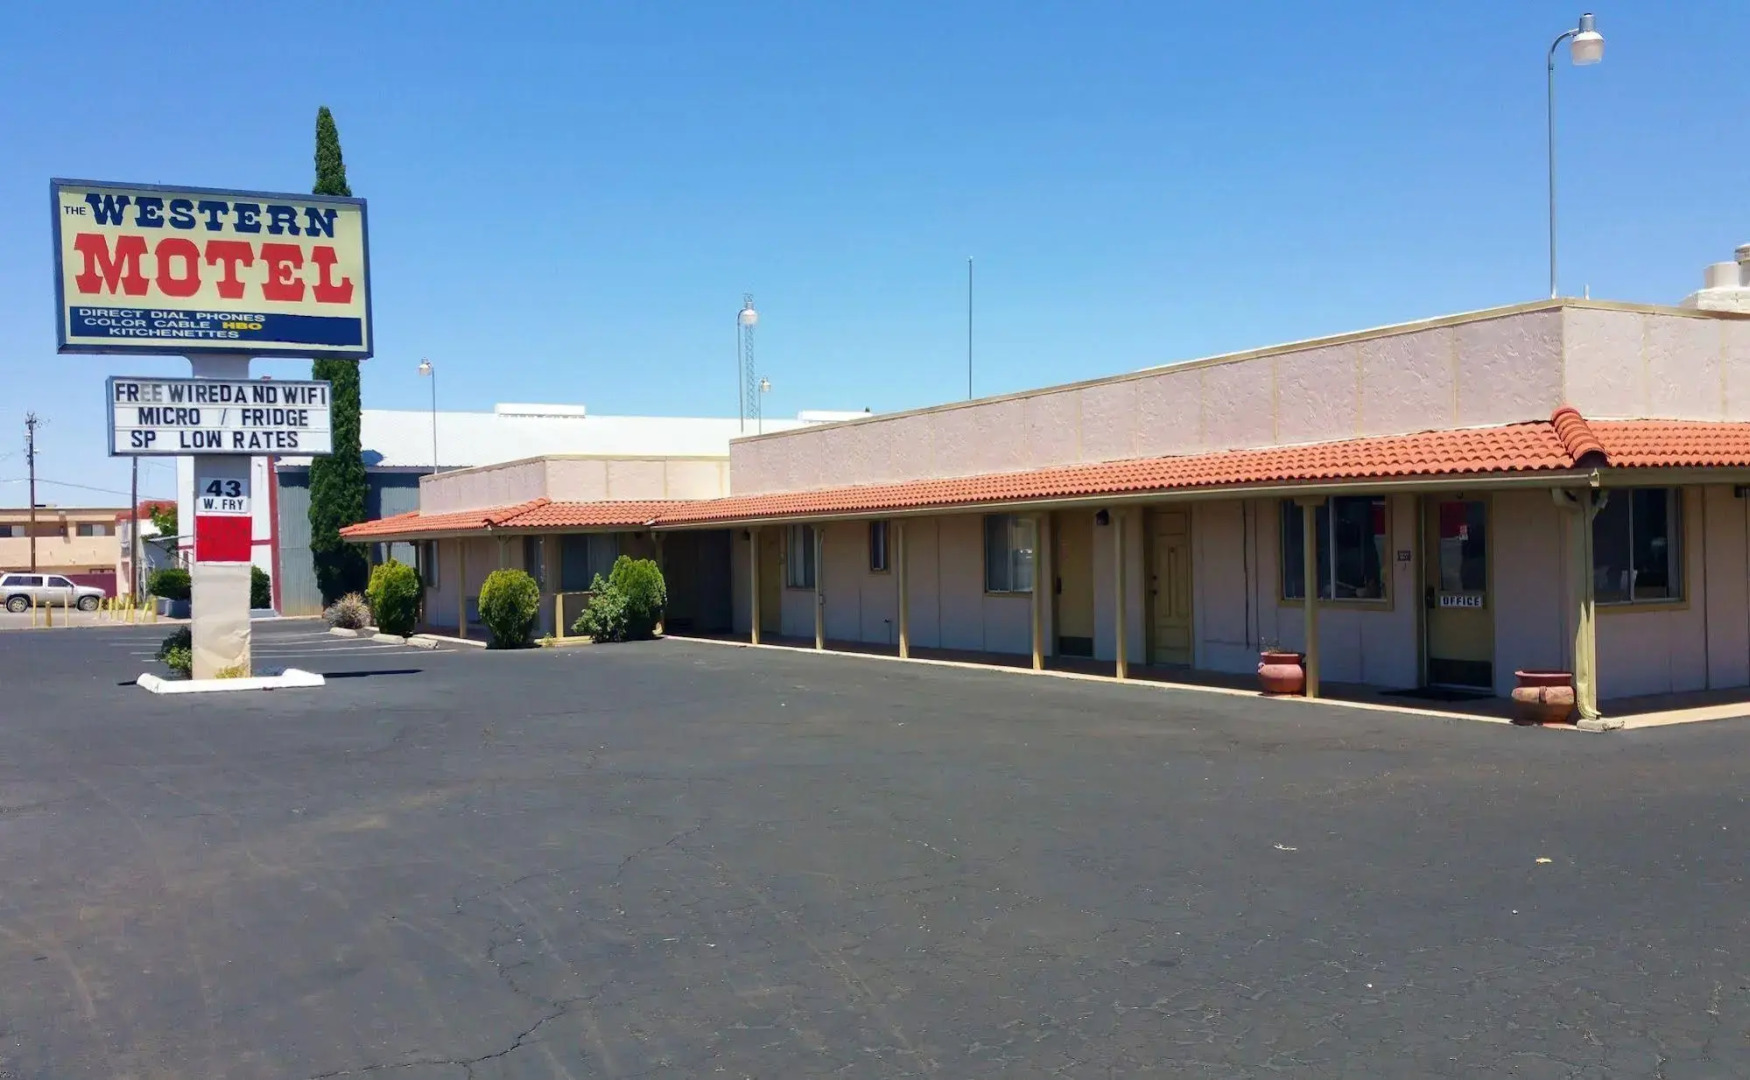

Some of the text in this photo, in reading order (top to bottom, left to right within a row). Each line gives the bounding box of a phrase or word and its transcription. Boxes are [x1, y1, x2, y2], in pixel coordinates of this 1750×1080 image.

[64, 193, 338, 238] THE WESTERN
[73, 233, 354, 304] MOTEL
[79, 309, 266, 322] DIRECT DIAL PHONES
[84, 318, 262, 330] COLOR CABLE HBO
[109, 328, 239, 338] KITCHENETTES
[115, 383, 162, 402] FREE
[282, 387, 326, 404] WIFI
[138, 407, 200, 425] MICRO
[242, 409, 308, 427] FRIDGE
[131, 430, 298, 449] SP LOW RATES
[206, 480, 242, 497] 43
[203, 499, 244, 511] W. FRY
[1443, 596, 1480, 606] OFFICE
